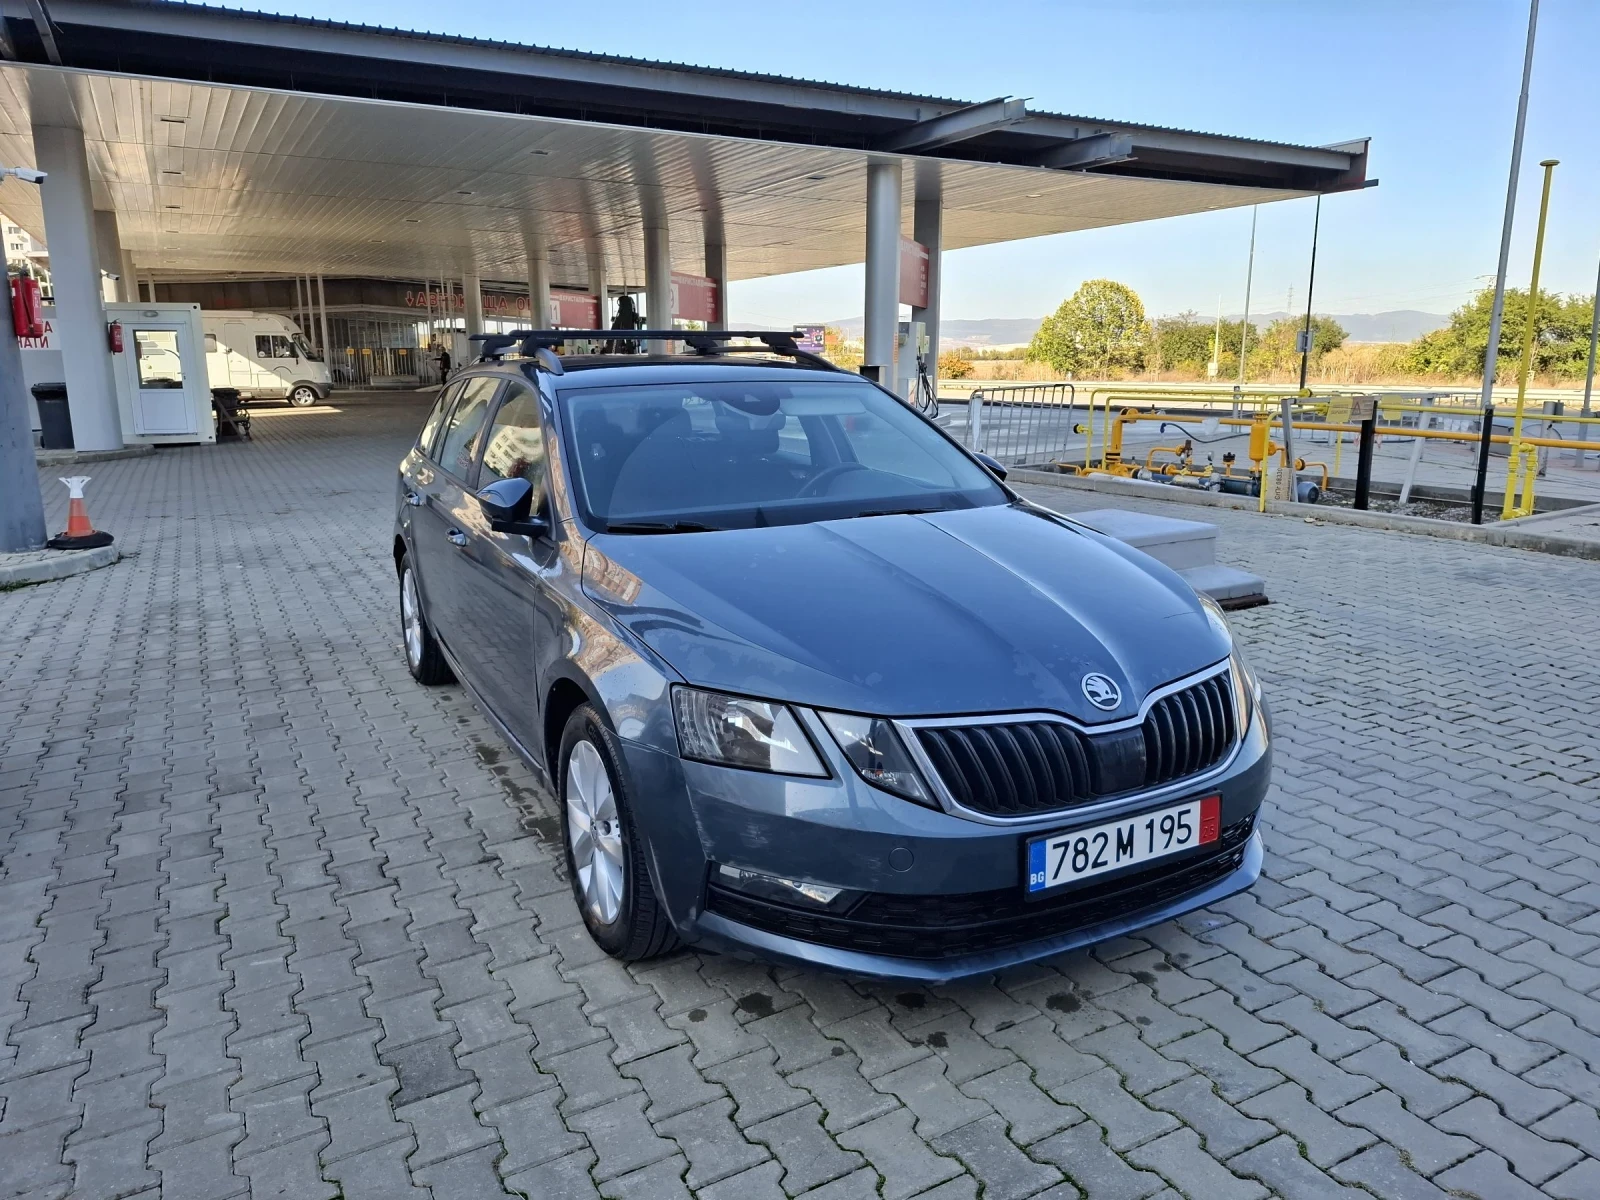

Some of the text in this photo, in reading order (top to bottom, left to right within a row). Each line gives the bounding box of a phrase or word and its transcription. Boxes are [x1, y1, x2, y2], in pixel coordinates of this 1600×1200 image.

[1030, 809, 1192, 885] BG 782 M 195
